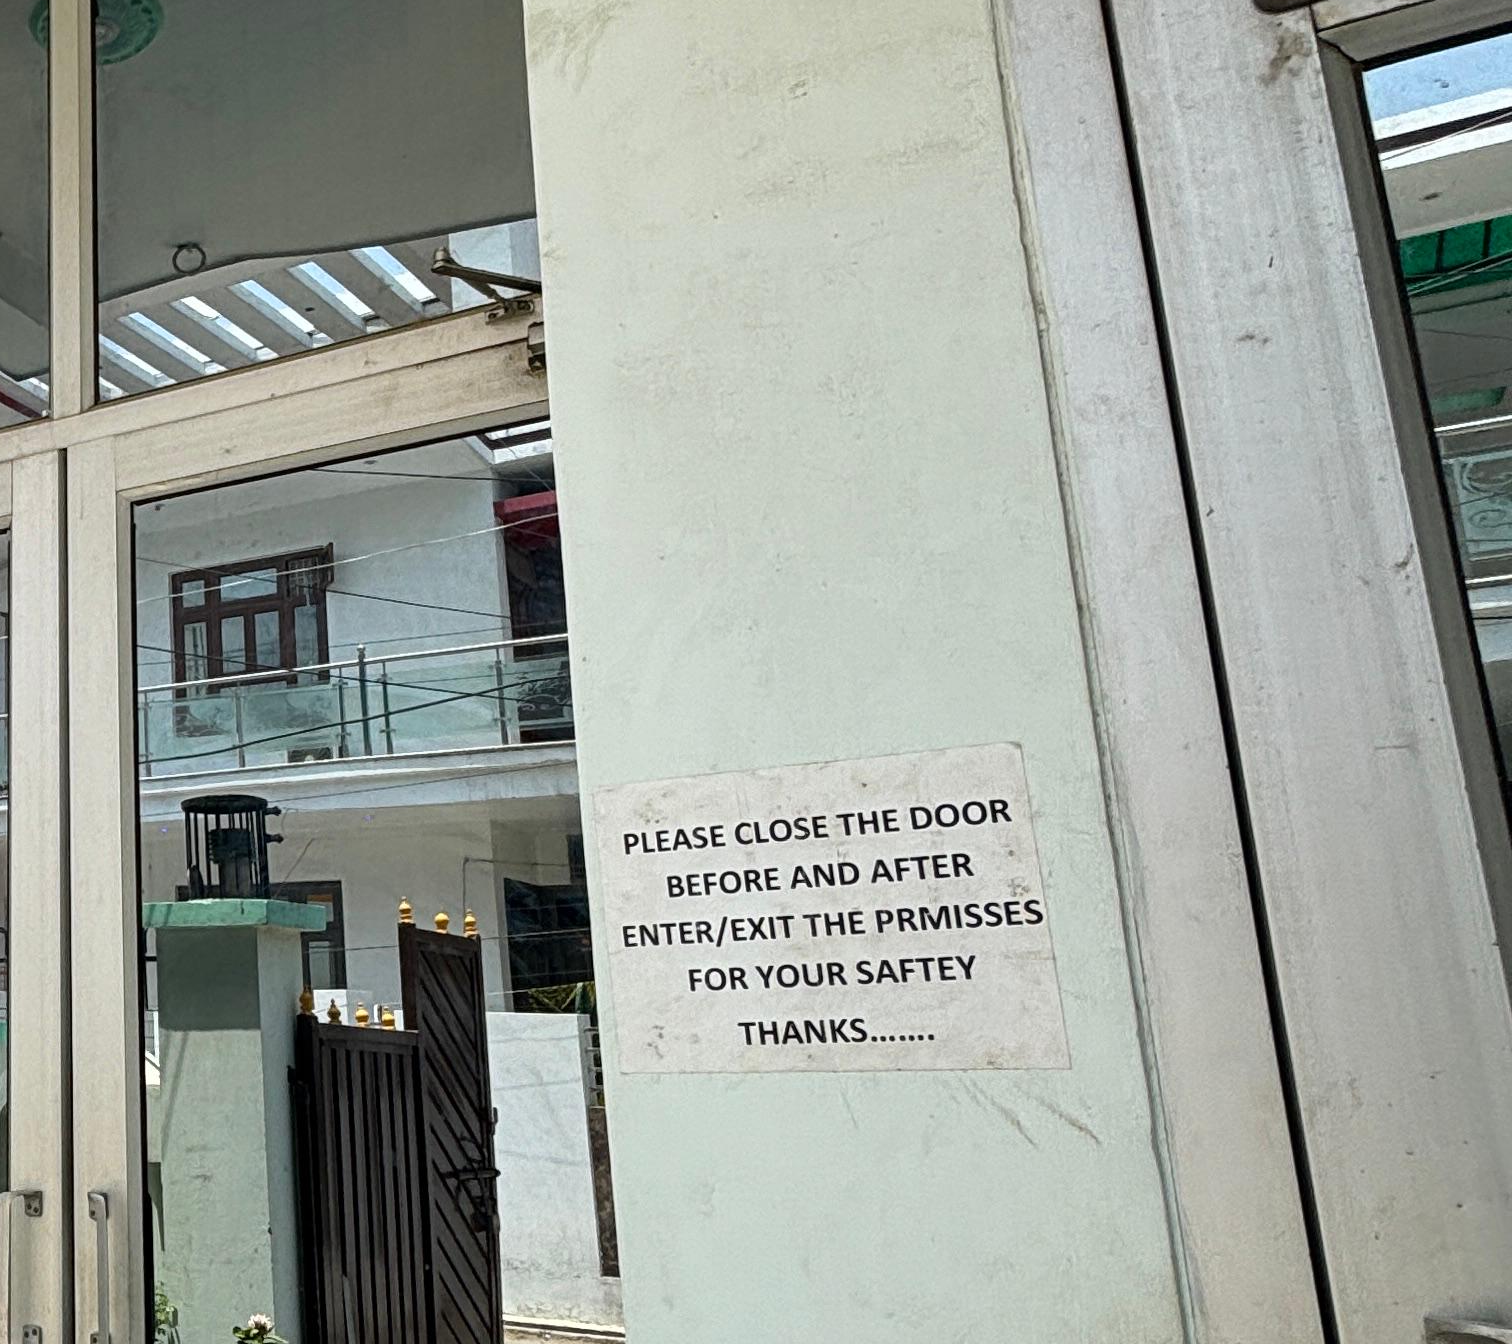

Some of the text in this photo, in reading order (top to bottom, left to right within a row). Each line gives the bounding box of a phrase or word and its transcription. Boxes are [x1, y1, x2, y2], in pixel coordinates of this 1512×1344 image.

[623, 799, 1012, 855] PLEASE CLOSE THE DOOR
[666, 853, 975, 898] BEFORE AND AFTER
[622, 899, 1044, 948] ENTER/EXIT THE PRMISSES
[688, 955, 976, 992] FOR YOUR SAFTEY
